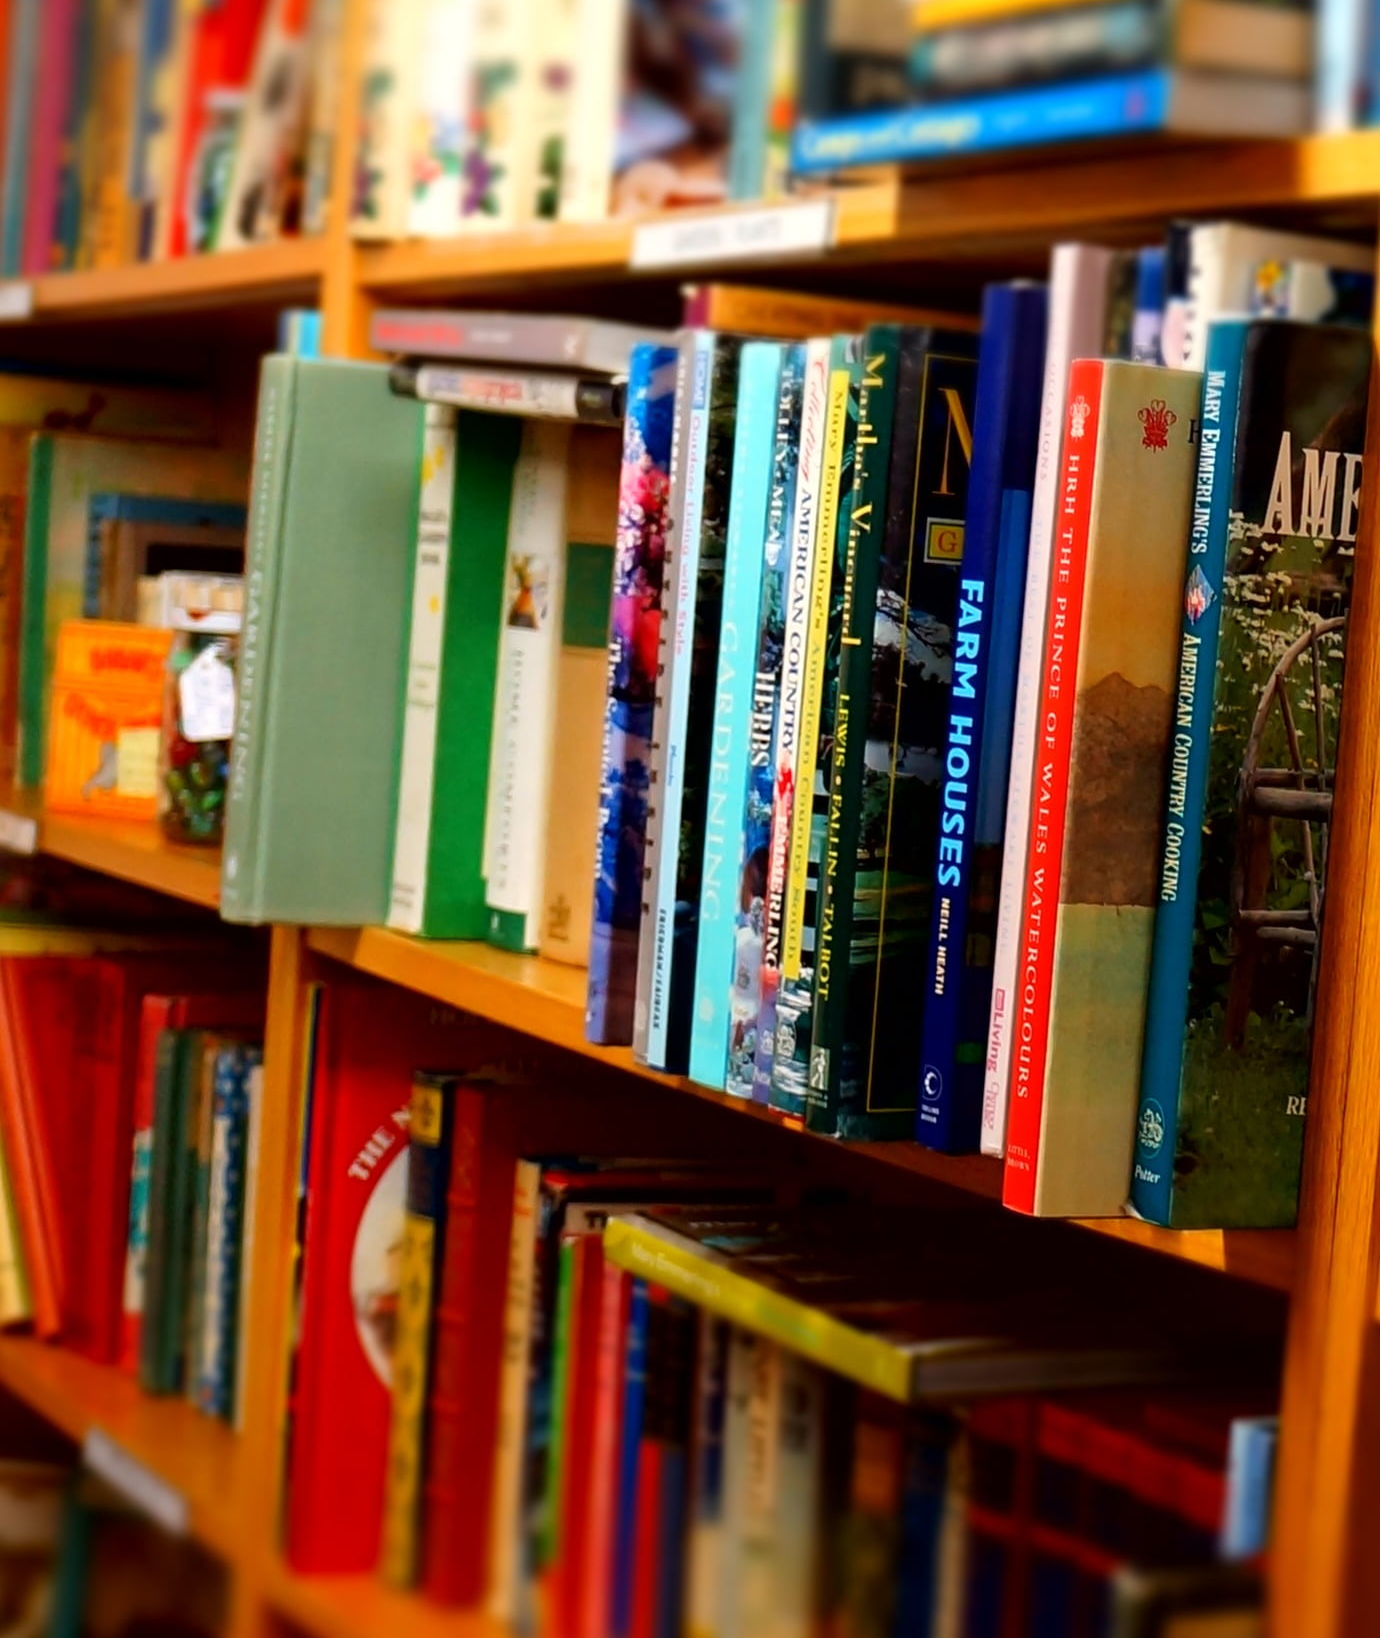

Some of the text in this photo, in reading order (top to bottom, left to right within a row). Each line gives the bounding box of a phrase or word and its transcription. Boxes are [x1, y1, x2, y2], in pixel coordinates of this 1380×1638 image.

[786, 490, 812, 627] AMERICAN
[783, 632, 803, 755] COUNTRY
[1160, 370, 1226, 903] MARY EMMERLING'S AMERICAN COUNTRY COOKING
[701, 620, 739, 922] GARDENING
[751, 671, 775, 768] HERBS
[933, 579, 985, 995] FARM HOUSES NEILL HEATH
[1016, 454, 1080, 1099] HRH THE PRINCE OF WALES WATERCOLOURS
[816, 694, 851, 1002] LEWIS FALLIN TALBOT
[986, 1013, 1005, 1074] Living
[346, 1125, 396, 1181] THE
[1134, 1164, 1162, 1185] Potter
